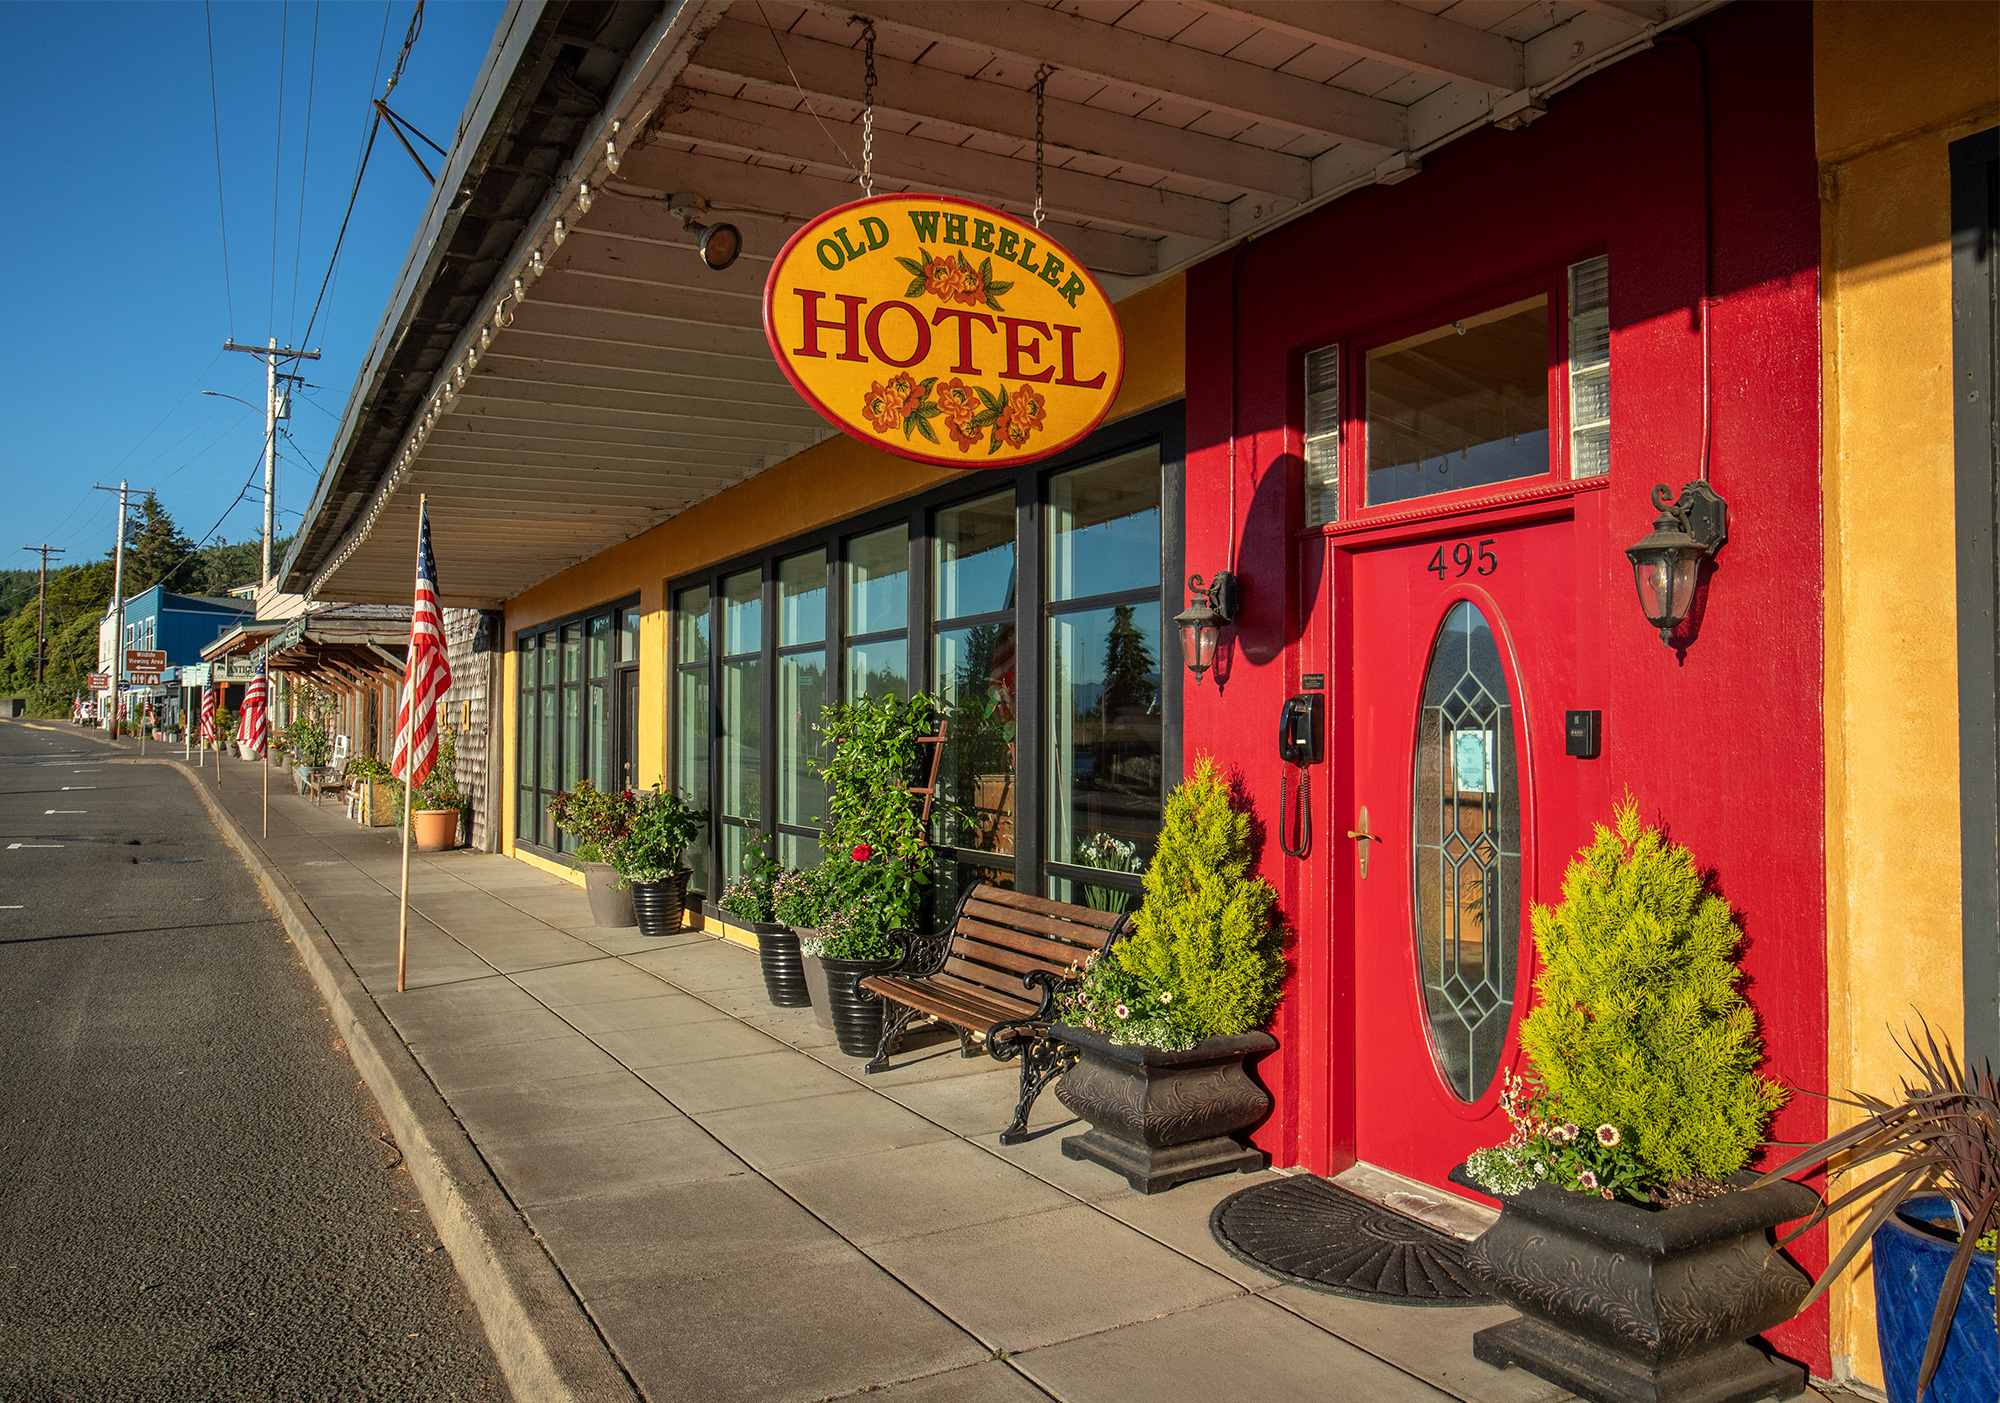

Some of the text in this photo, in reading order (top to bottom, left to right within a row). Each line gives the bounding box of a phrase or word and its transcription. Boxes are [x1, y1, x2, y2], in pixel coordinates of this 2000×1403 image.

[816, 210, 1086, 309] OLD WHEELER
[793, 288, 1107, 389] HOTEL
[1427, 538, 1498, 580] 495
[227, 665, 256, 676] ANTIQU
